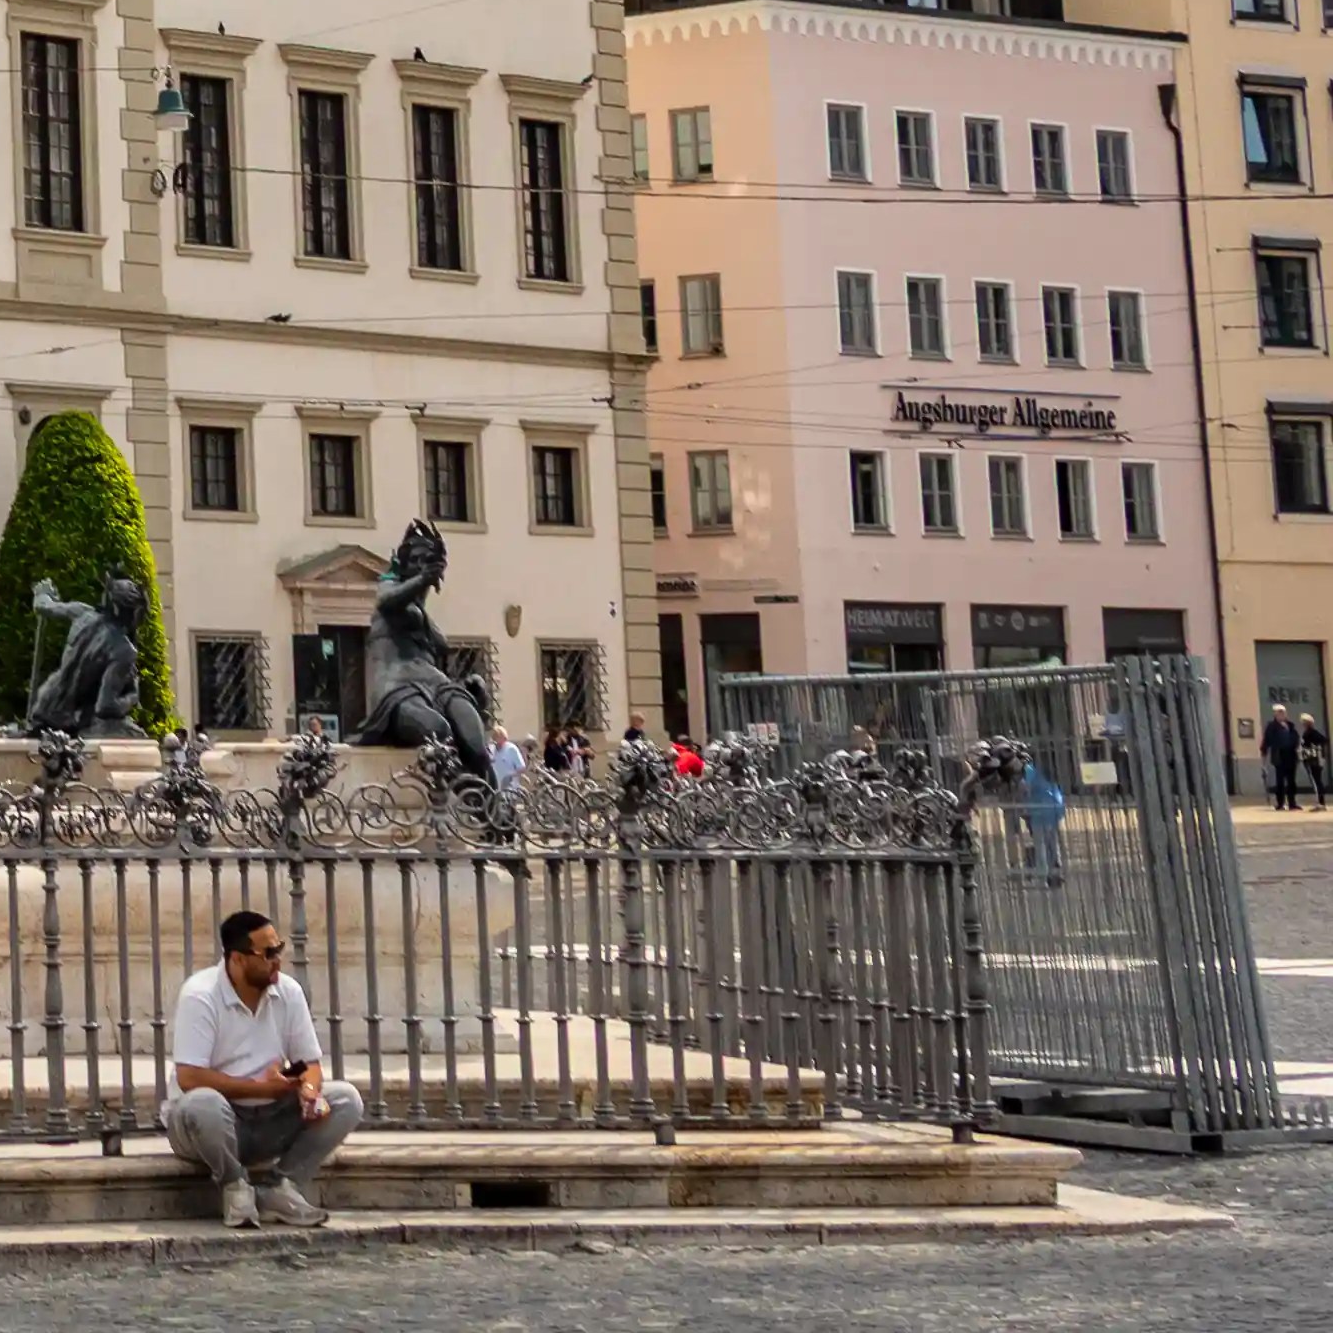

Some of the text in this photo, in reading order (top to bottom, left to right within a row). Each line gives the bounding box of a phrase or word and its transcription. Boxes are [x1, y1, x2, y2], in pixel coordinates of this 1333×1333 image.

[893, 391, 1117, 436] Augsburger Allgemeine
[1268, 686, 1310, 704] REWE
